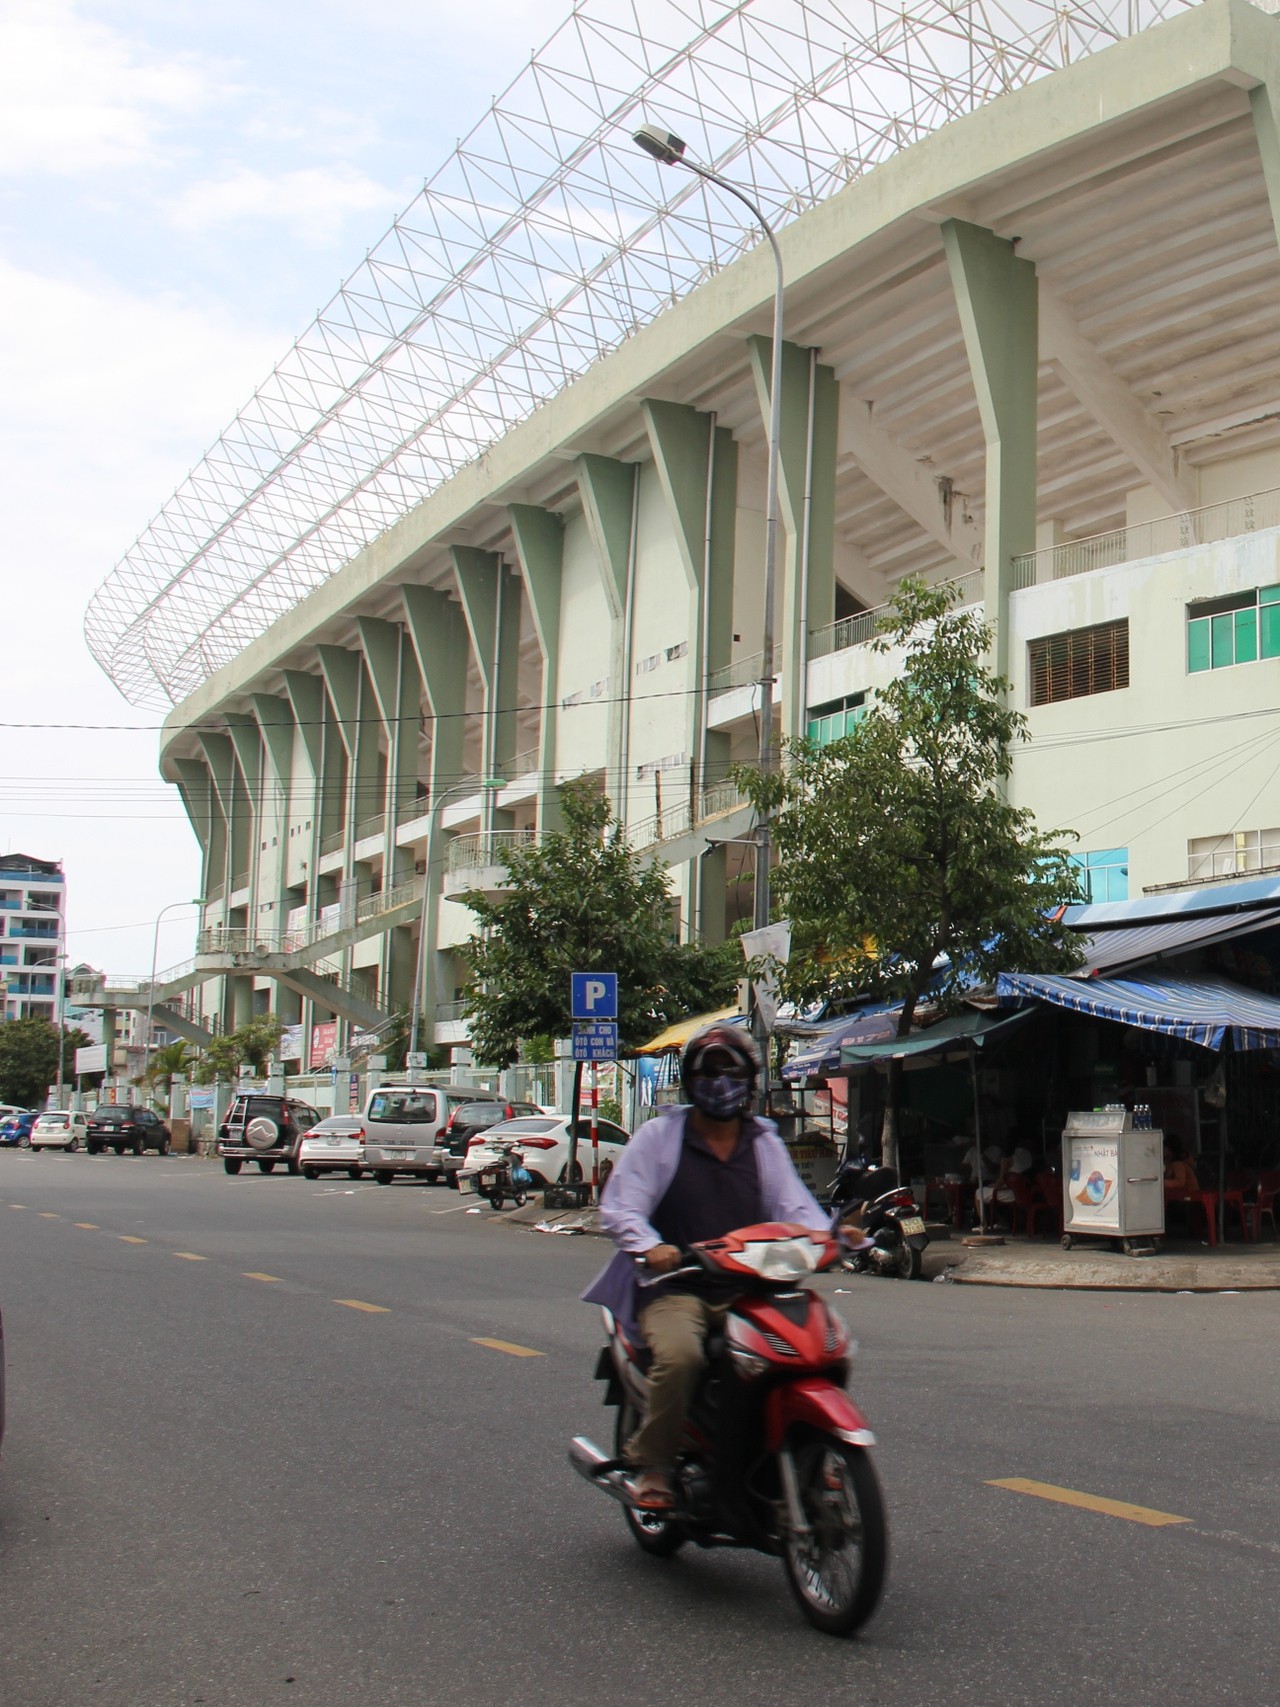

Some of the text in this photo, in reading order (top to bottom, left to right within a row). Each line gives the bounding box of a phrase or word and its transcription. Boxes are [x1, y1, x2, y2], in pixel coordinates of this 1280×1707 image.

[585, 981, 606, 1010] P
[578, 1026, 612, 1034] NH CHO
[590, 1037, 604, 1046] CON
